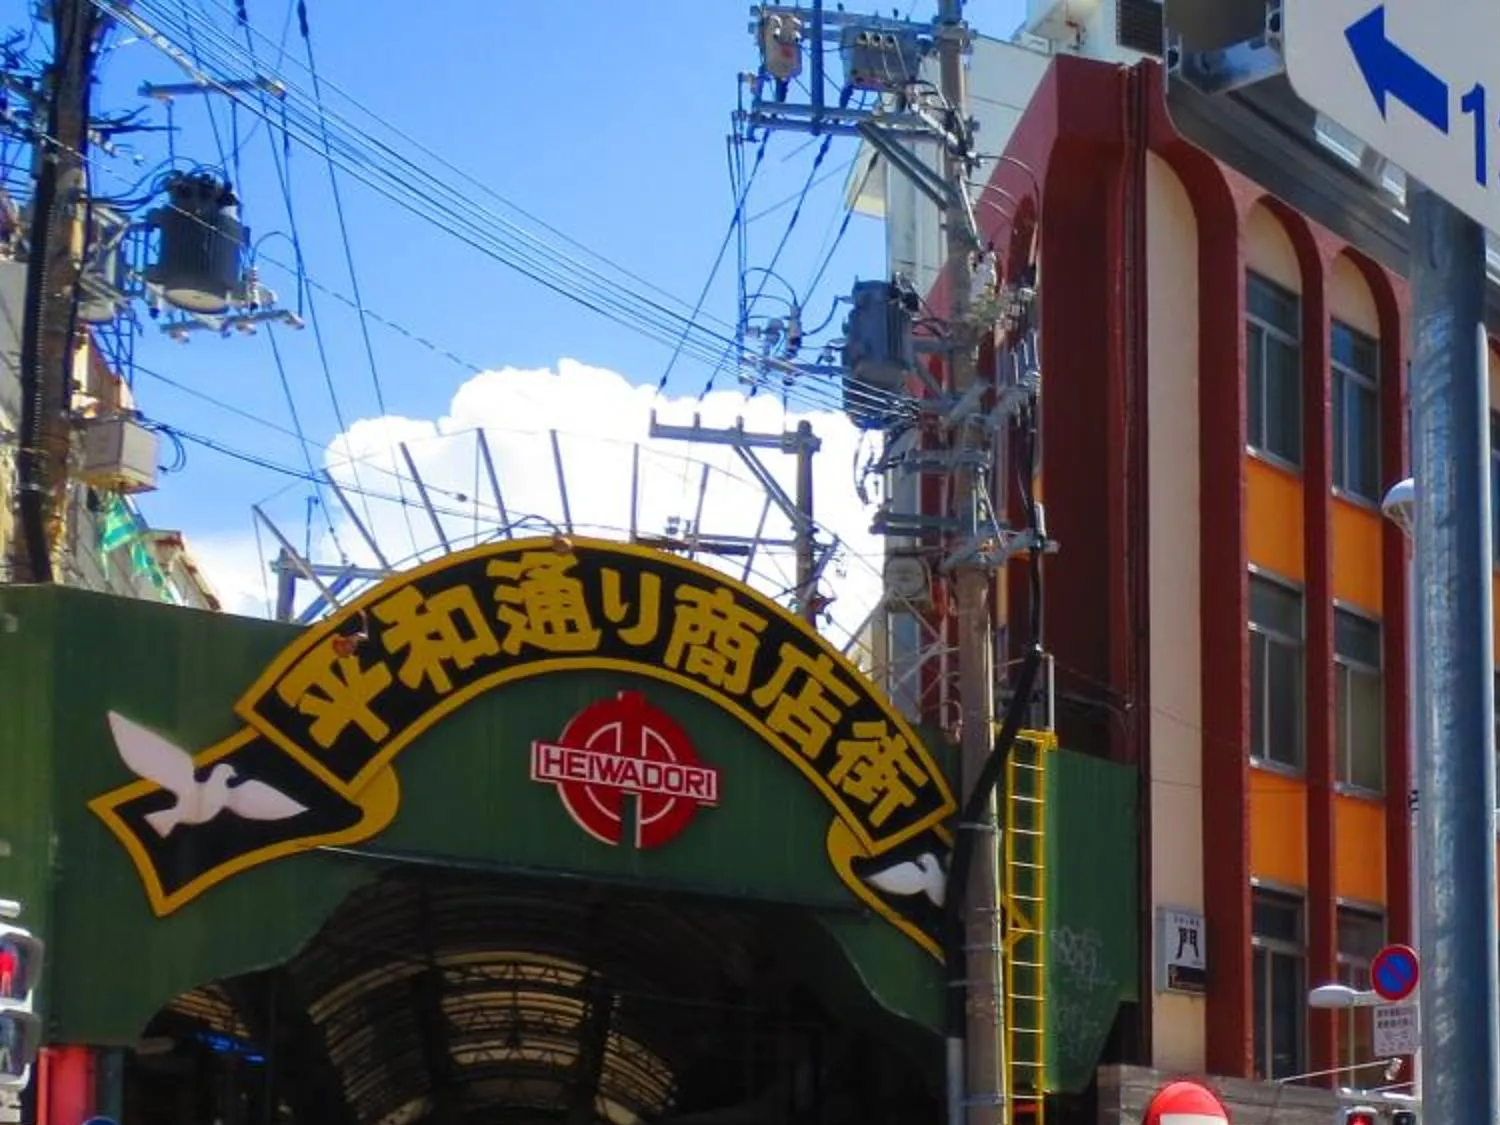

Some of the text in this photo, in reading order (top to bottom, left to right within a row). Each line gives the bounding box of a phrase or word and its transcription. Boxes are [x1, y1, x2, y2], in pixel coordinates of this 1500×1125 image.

[280, 551, 929, 829] 平和通り商店街
[543, 747, 713, 797] HEIWADORI
[1176, 927, 1199, 960] 門
